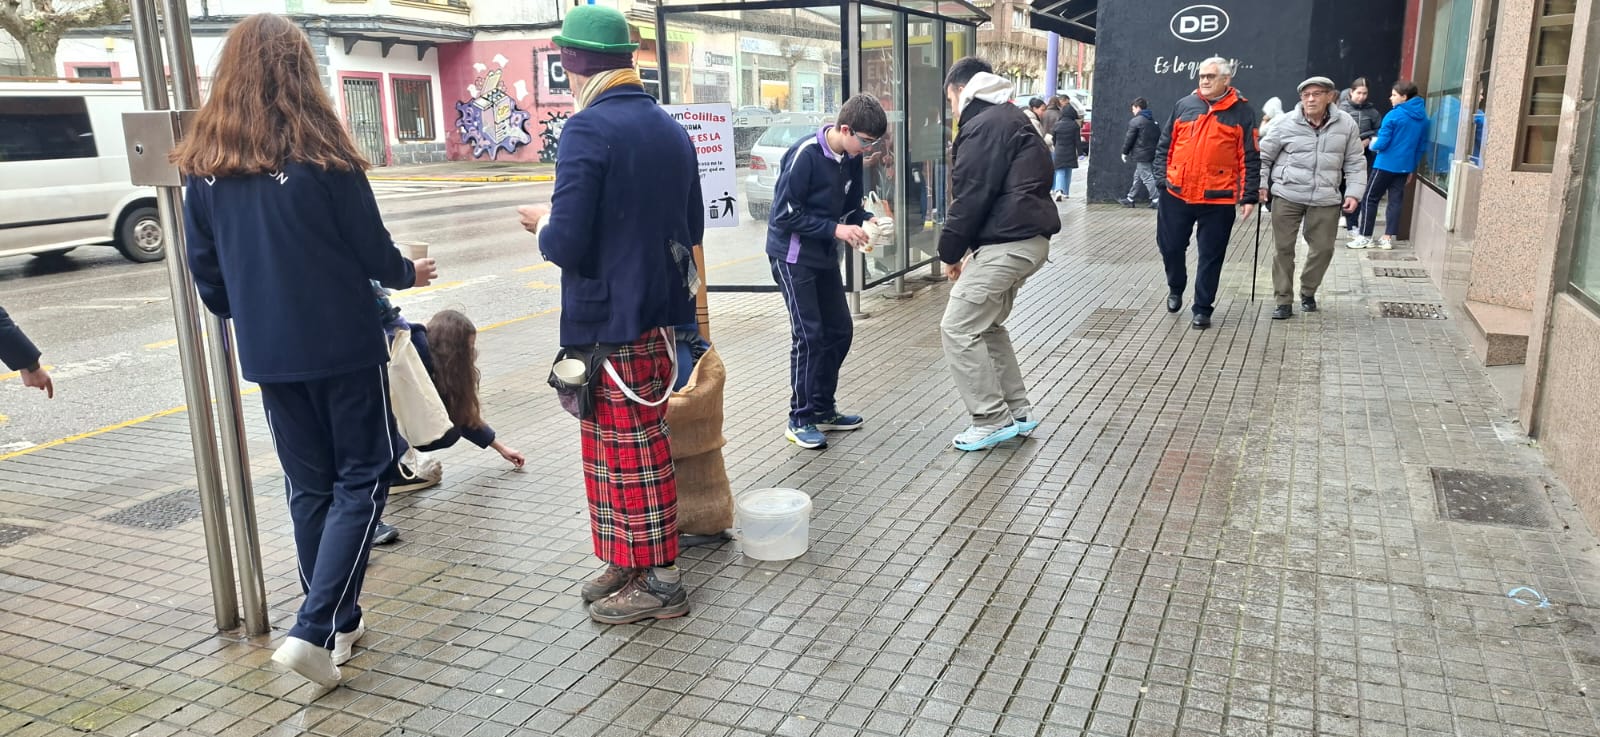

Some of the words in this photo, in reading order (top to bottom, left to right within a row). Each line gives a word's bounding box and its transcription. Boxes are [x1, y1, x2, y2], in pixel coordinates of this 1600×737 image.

[1179, 15, 1219, 33] DB
[1154, 56, 1171, 73] Es
[1173, 56, 1187, 73] lo
[698, 133, 707, 142] ES
[710, 132, 720, 140] LA
